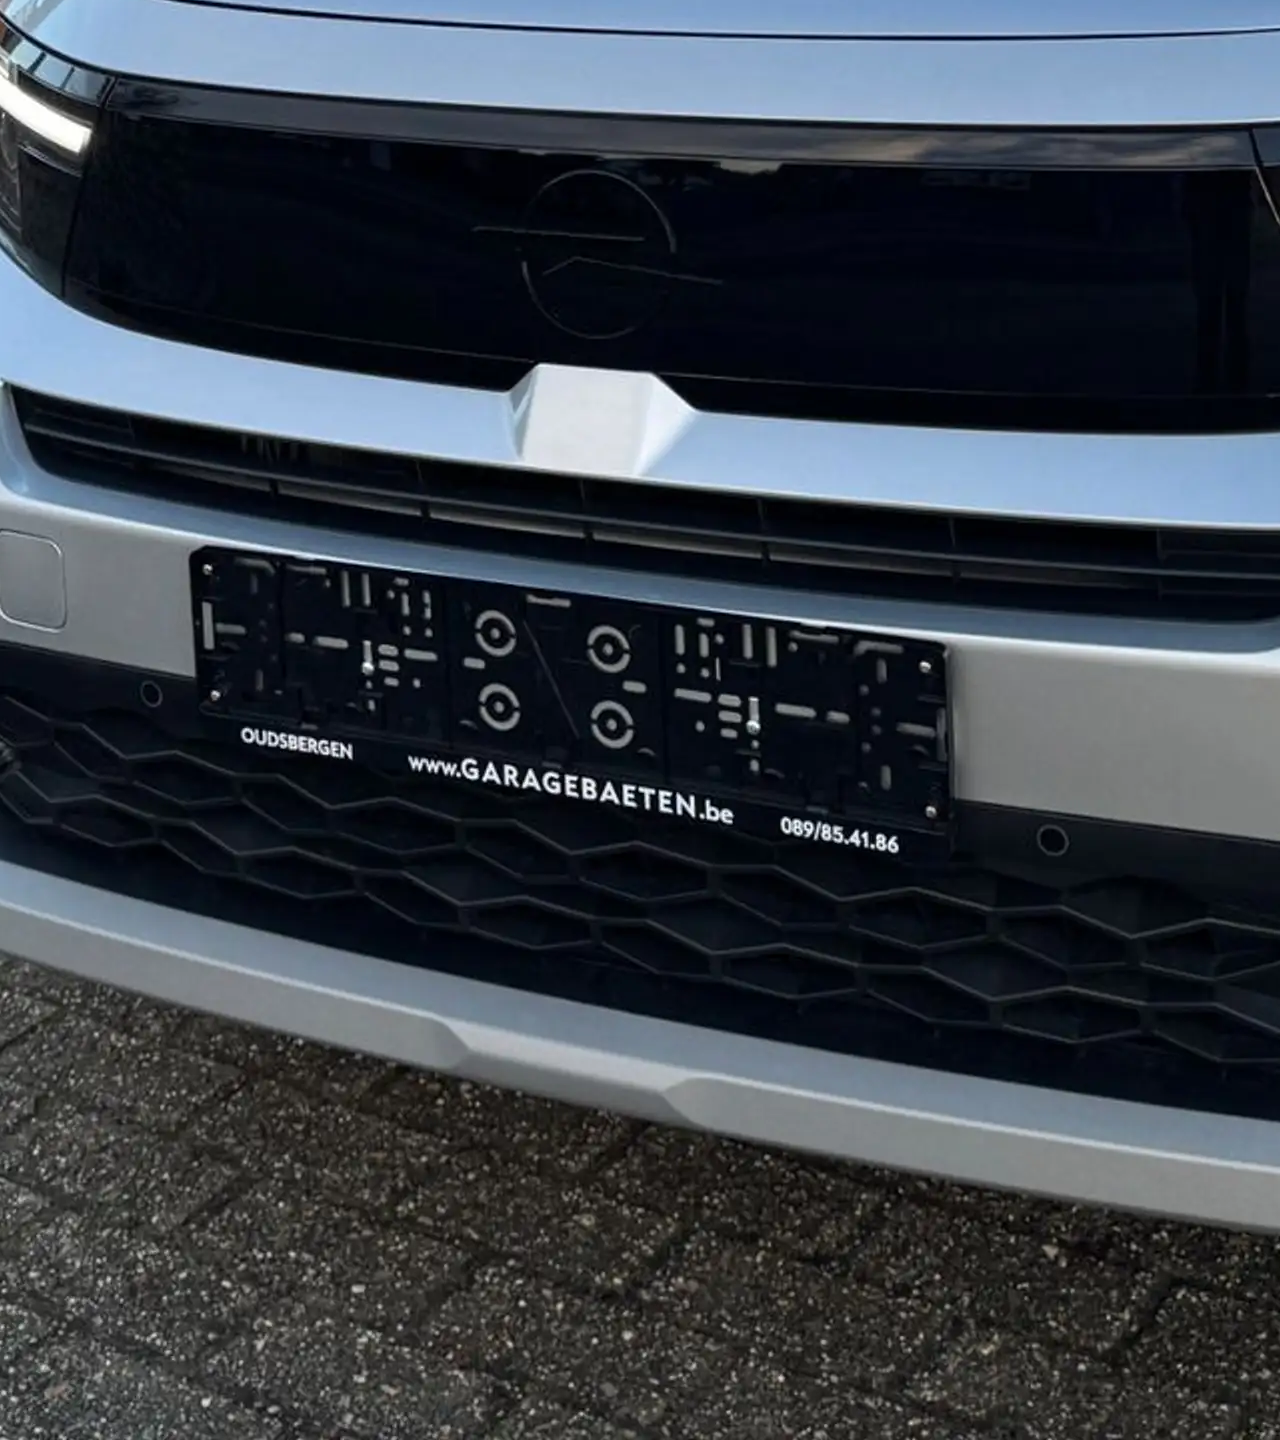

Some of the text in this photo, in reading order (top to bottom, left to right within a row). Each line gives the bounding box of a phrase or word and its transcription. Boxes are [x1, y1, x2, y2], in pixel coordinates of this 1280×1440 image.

[240, 726, 354, 761] OUDSBERGEN
[407, 755, 735, 825] www.GARAGEBAETEN.be
[779, 815, 900, 854] 089/85.41.86
